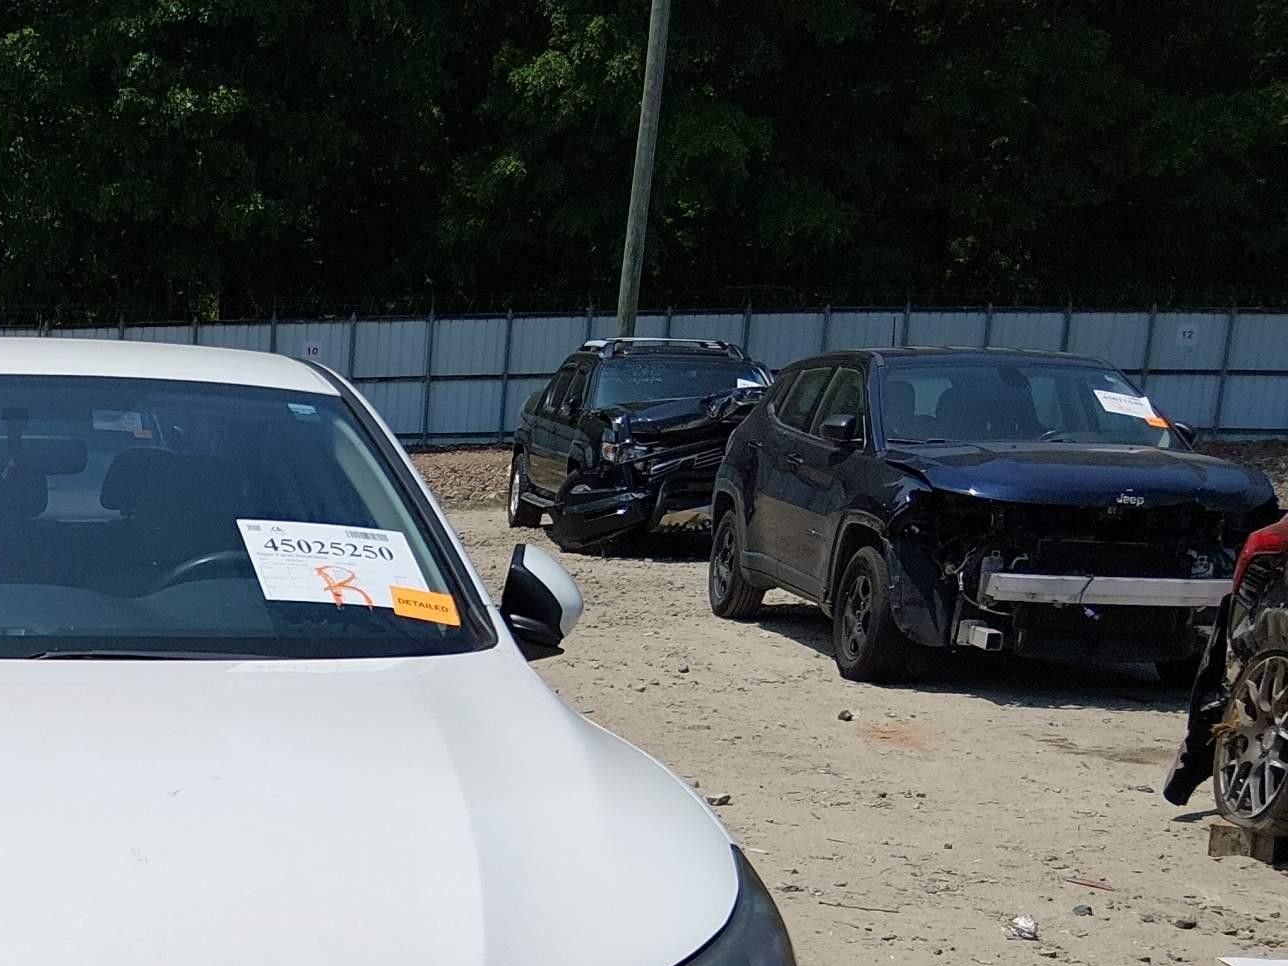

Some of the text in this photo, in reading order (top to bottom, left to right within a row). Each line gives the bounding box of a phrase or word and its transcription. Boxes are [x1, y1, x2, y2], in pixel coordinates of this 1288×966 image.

[1181, 329, 1194, 340] 12
[306, 346, 319, 356] 10
[1115, 492, 1145, 508] Jeep
[263, 536, 395, 562] 45025250
[396, 597, 449, 613] DETAILED
